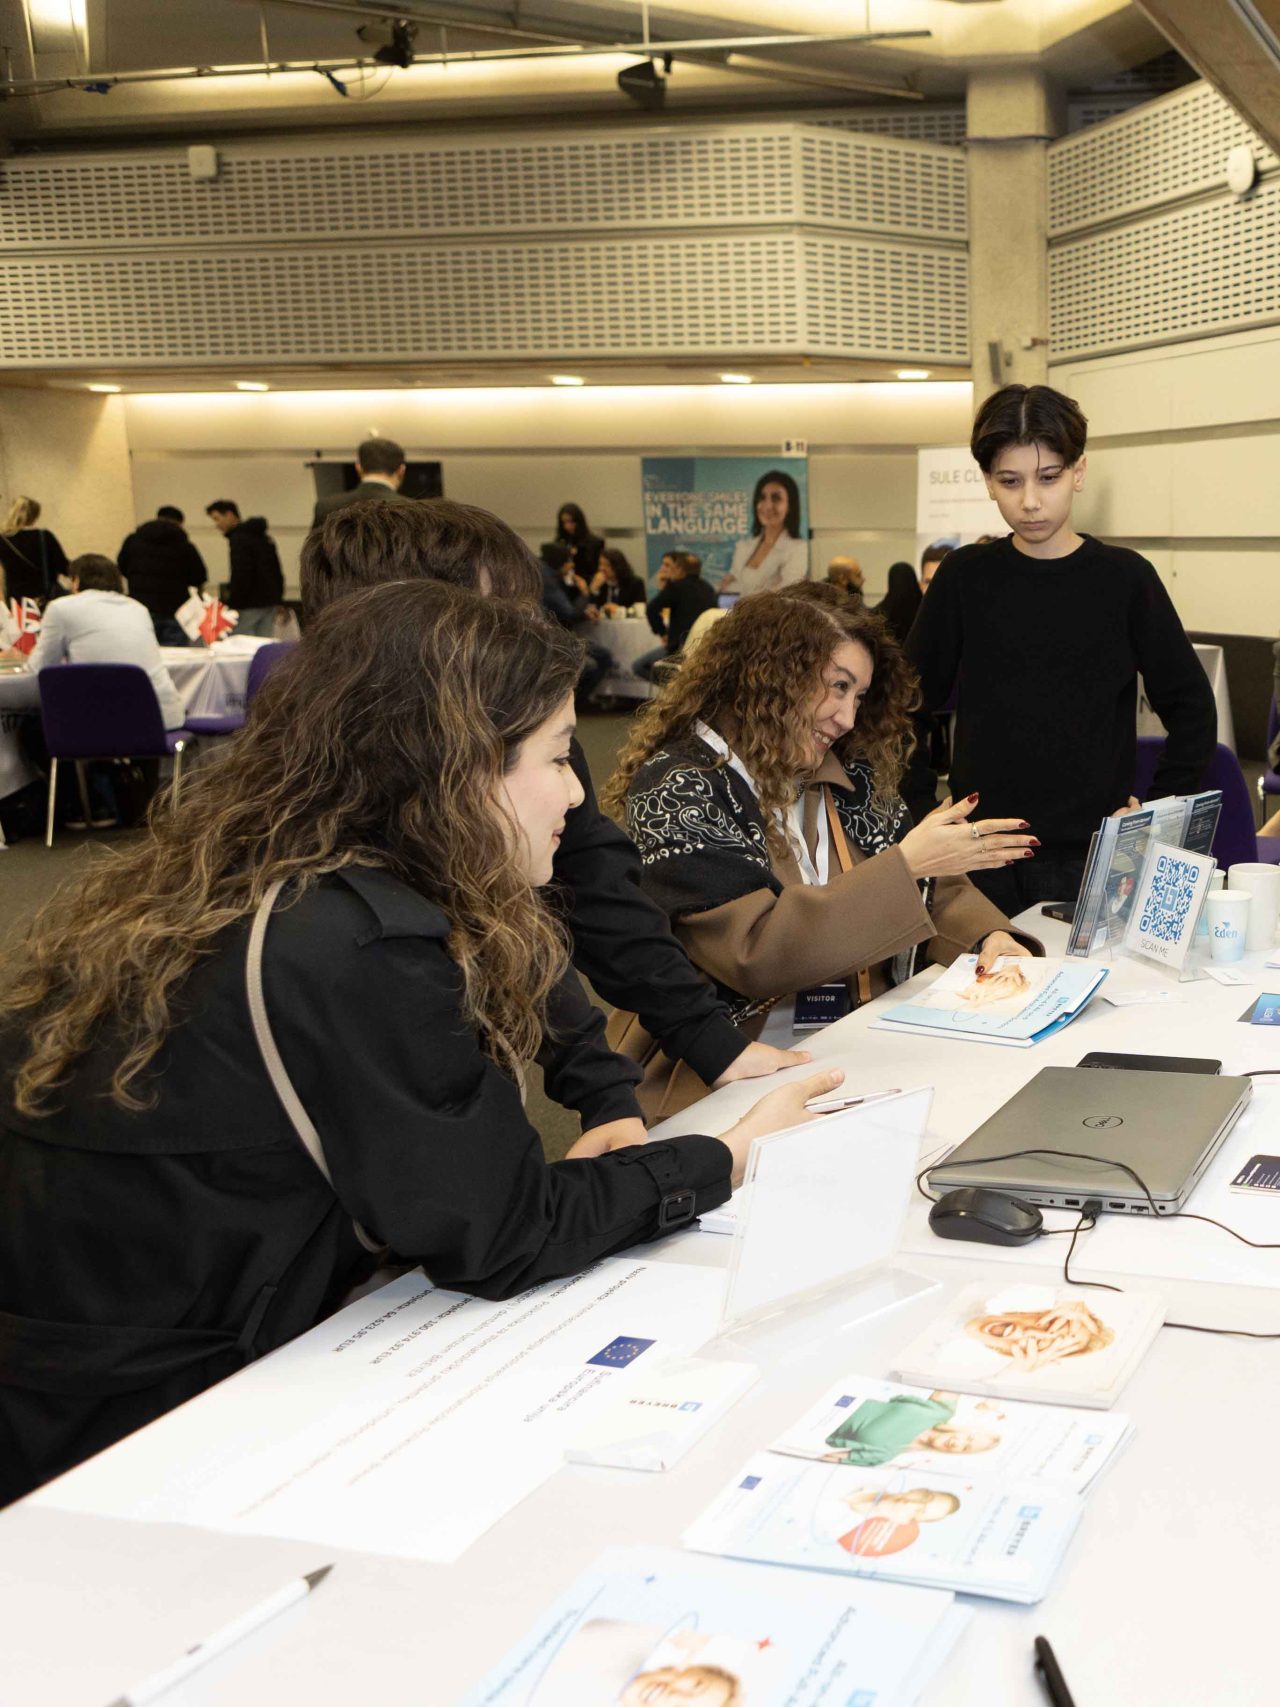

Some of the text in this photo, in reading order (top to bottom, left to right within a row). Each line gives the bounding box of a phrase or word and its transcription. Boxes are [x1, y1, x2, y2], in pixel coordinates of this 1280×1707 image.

[929, 470, 961, 484] SULE
[645, 492, 708, 504] EVERYONE
[646, 502, 749, 518] IN THE SAME
[646, 517, 749, 535] LANGUAGE
[1214, 925, 1239, 939] Eden
[1140, 940, 1170, 957] SCAN ME
[333, 1338, 356, 1353] EUR
[370, 1350, 392, 1365] EUR
